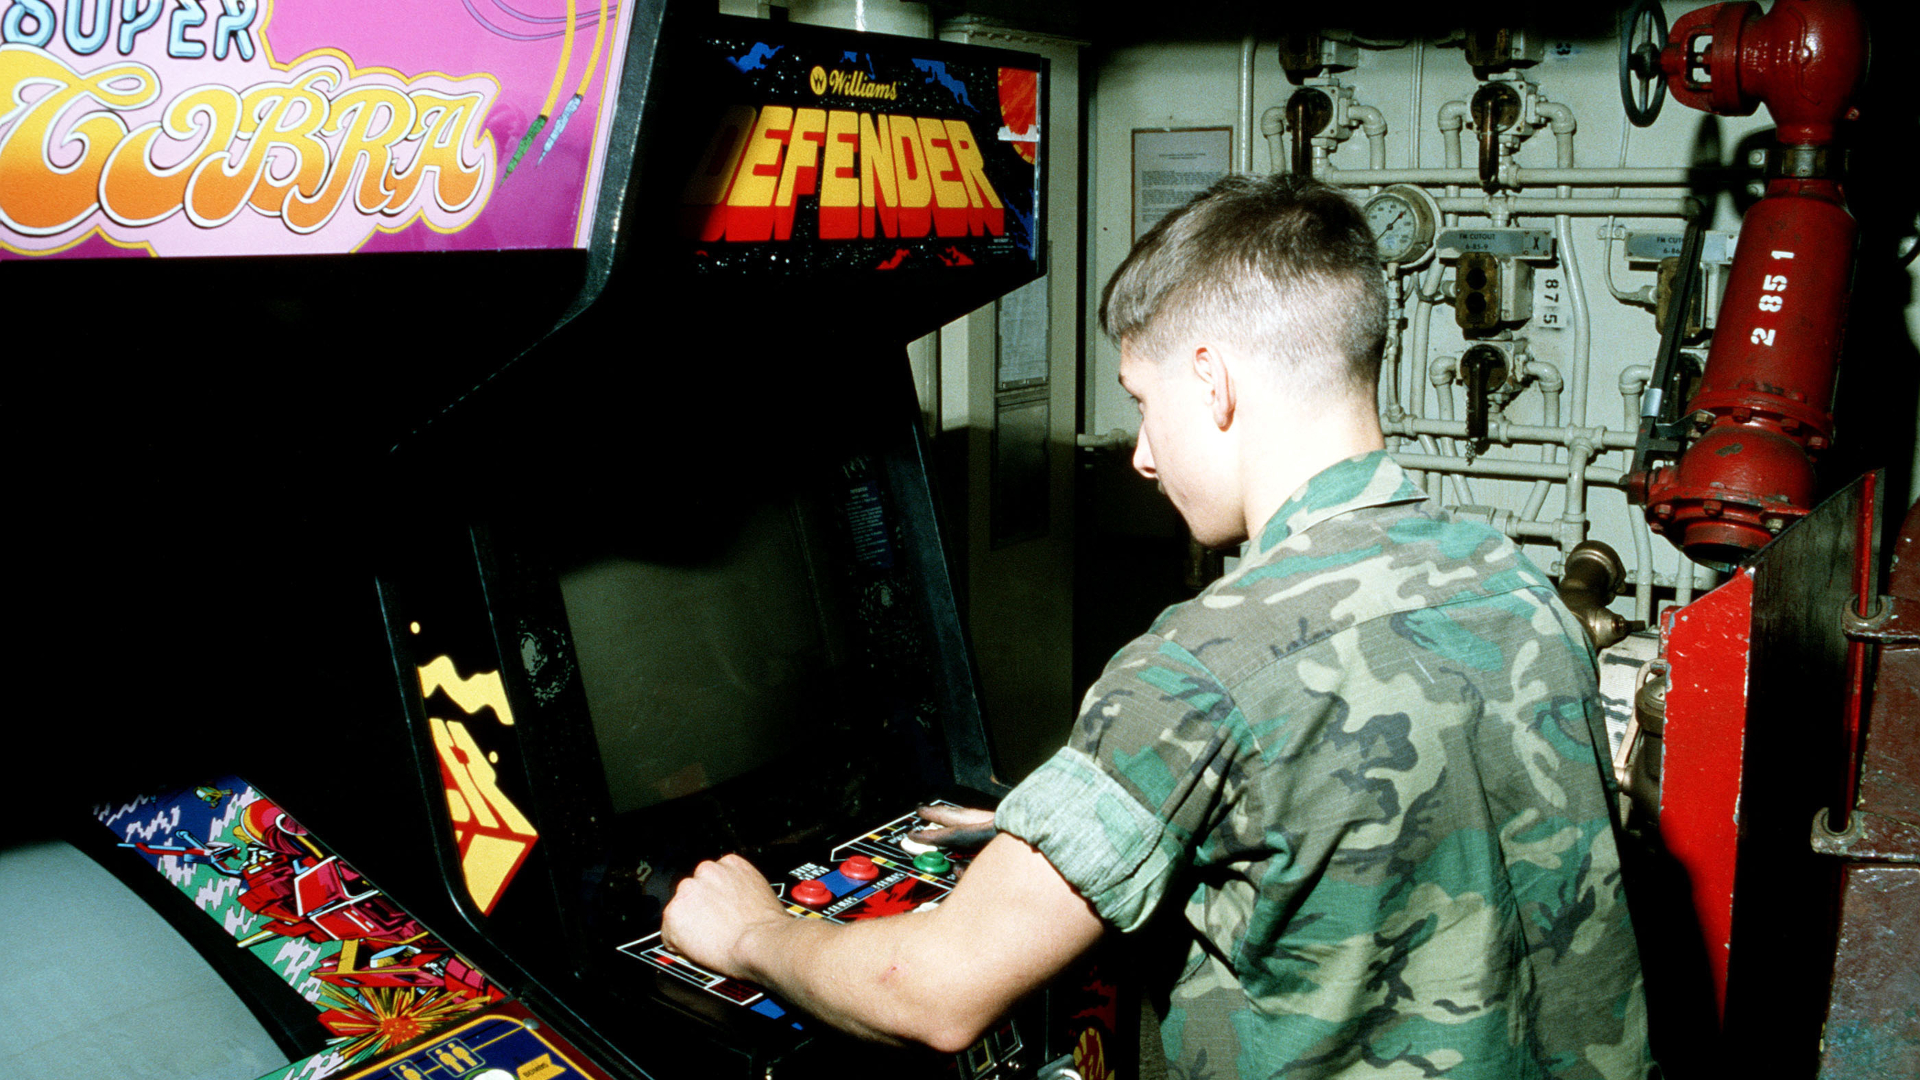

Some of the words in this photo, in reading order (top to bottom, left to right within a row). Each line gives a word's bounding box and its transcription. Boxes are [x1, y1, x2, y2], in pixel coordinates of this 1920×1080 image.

[829, 69, 897, 101] Williams
[0, 43, 486, 236] COBRA
[682, 104, 1005, 242] DEFENDER
[1533, 236, 1540, 250] X
